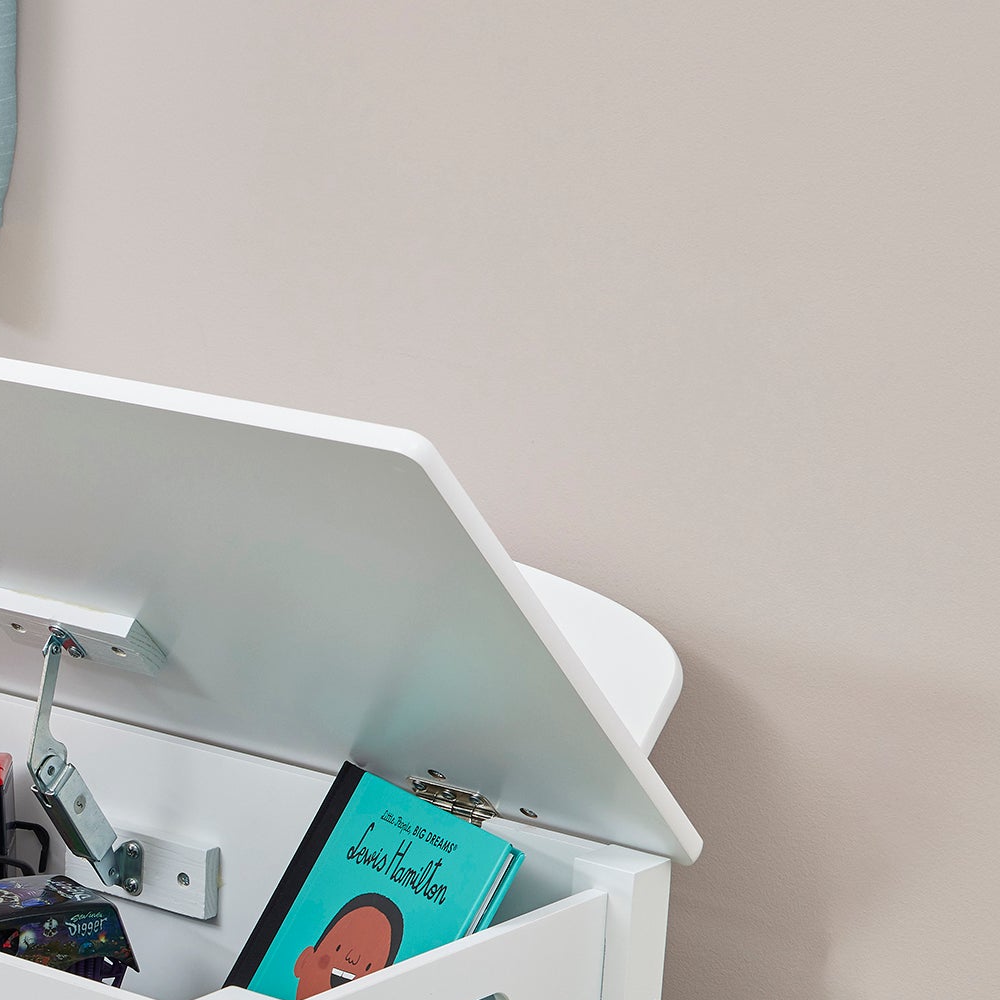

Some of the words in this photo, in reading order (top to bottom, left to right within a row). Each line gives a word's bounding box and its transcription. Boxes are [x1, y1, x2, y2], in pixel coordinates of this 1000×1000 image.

[380, 810, 395, 825] Little
[394, 816, 412, 834] People,
[412, 826, 427, 839] BIG
[346, 822, 388, 873] Lewis
[384, 839, 448, 905] Hamilton
[65, 917, 108, 937] Digger
